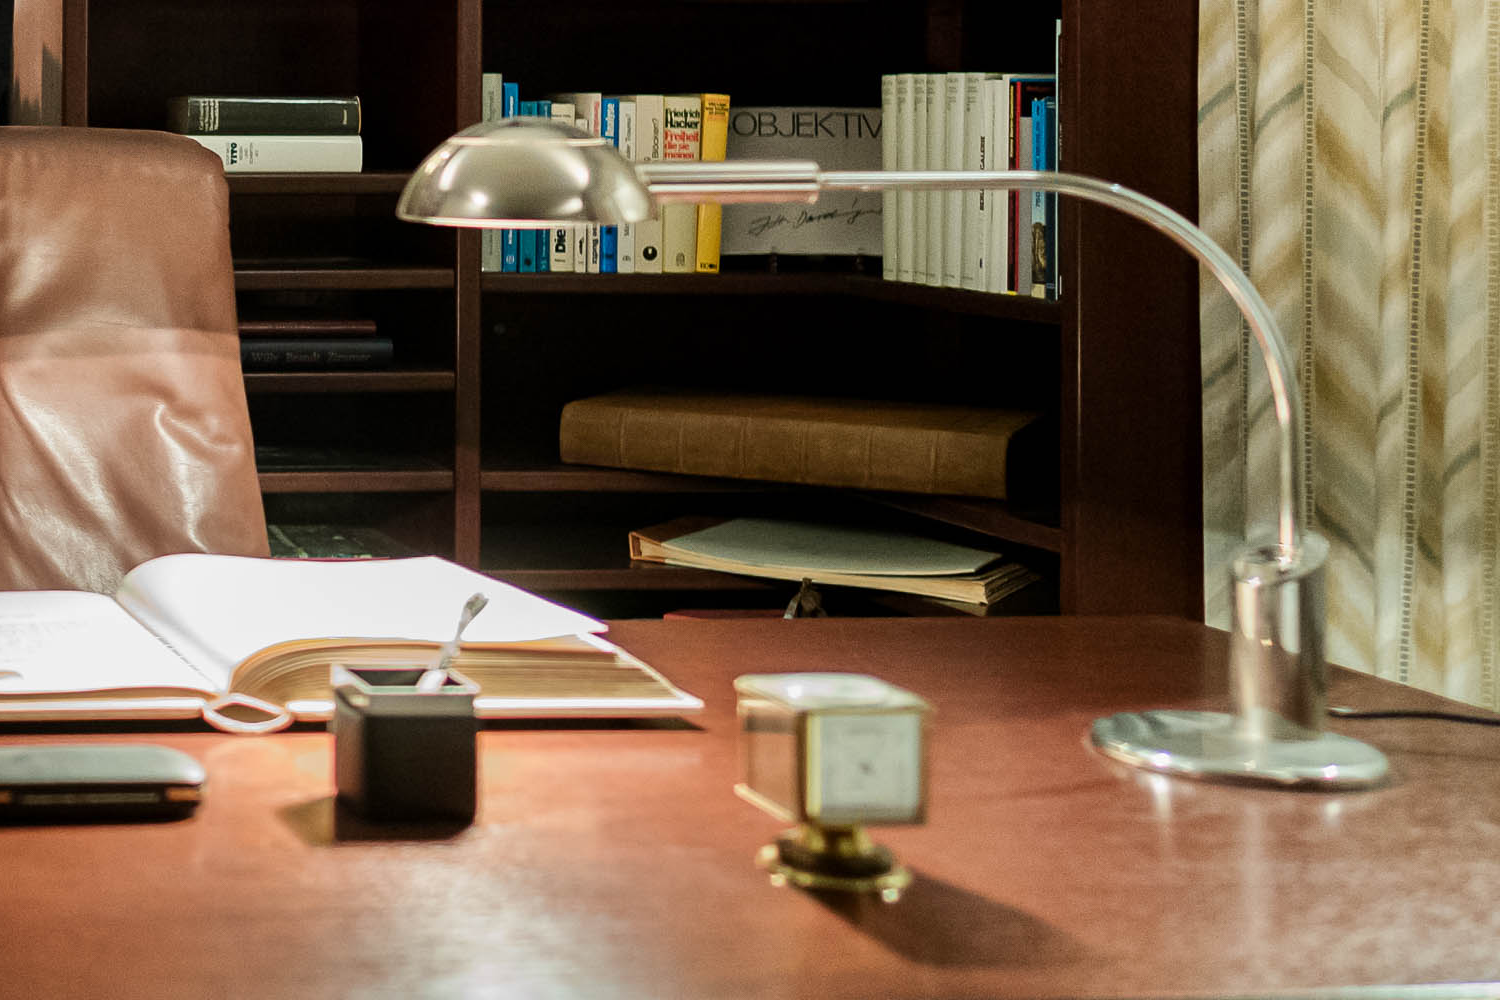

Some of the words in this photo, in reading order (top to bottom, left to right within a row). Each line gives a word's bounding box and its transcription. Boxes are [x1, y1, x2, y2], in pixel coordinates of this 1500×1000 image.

[665, 117, 700, 129] Hacker
[664, 131, 699, 142] Freiheit
[230, 142, 238, 165] TITO
[555, 229, 566, 253] Die
